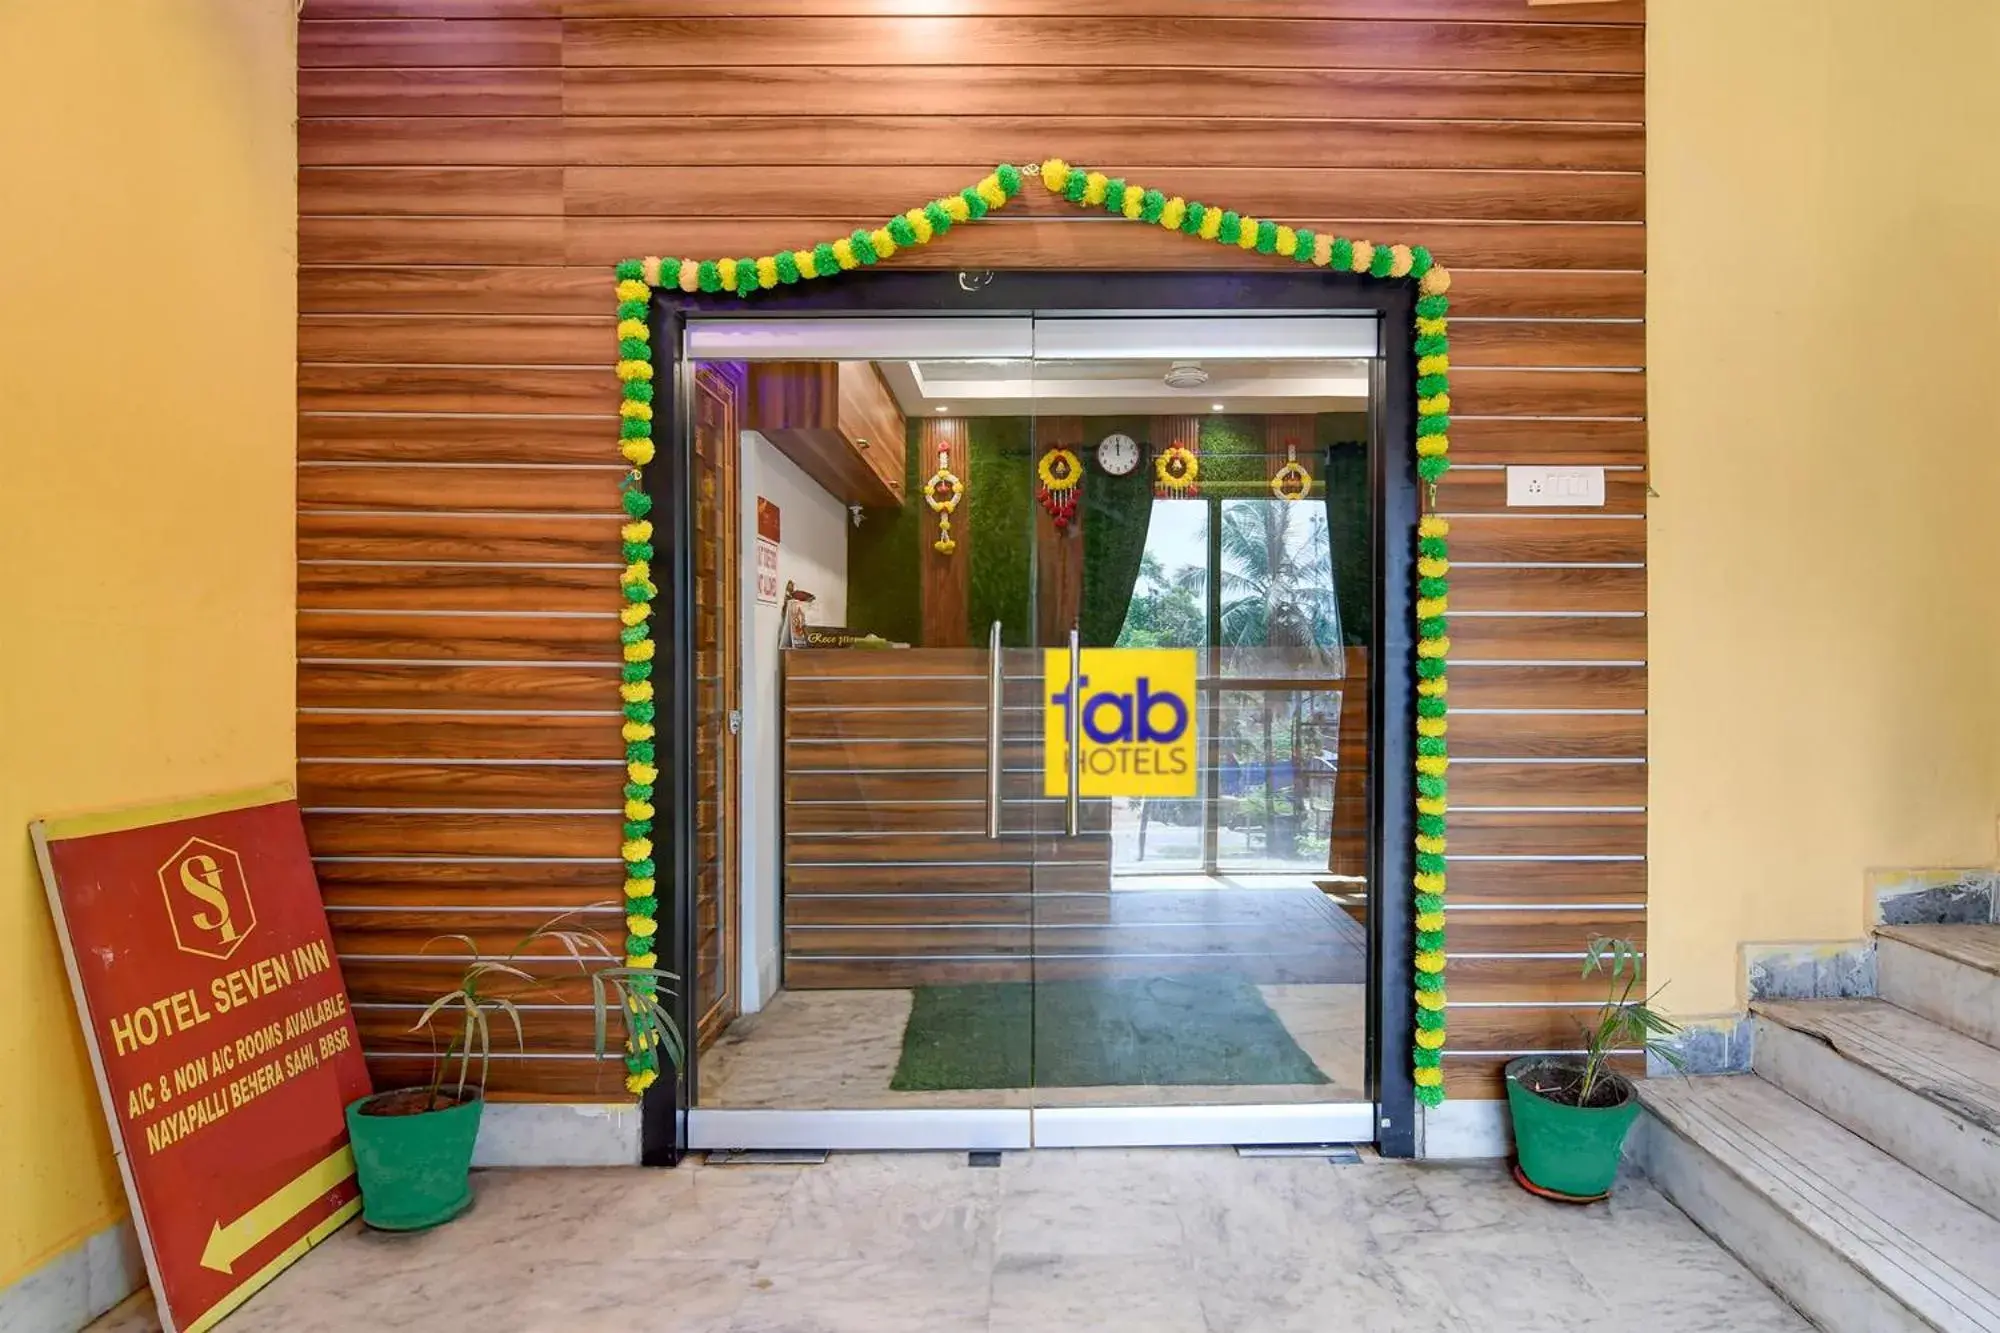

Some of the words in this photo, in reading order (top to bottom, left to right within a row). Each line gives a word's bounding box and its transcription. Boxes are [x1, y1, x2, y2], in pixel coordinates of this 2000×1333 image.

[1051, 675, 1188, 744] fab
[1064, 748, 1188, 775] HOTELS
[110, 989, 211, 1057] HOTEL
[211, 953, 292, 1014] SEVEN
[291, 938, 331, 981] INN
[129, 1082, 156, 1119] A/C
[159, 1075, 172, 1102] &
[174, 1056, 209, 1095] NON
[212, 1045, 235, 1078] A/C
[235, 1022, 284, 1064] ROOMS
[285, 992, 347, 1041] AVAILABLE
[146, 1087, 230, 1155] NAYAPALLI
[229, 1059, 285, 1108] BEHERA
[284, 1042, 320, 1079] SAHI,
[318, 1026, 351, 1061] BBSR
